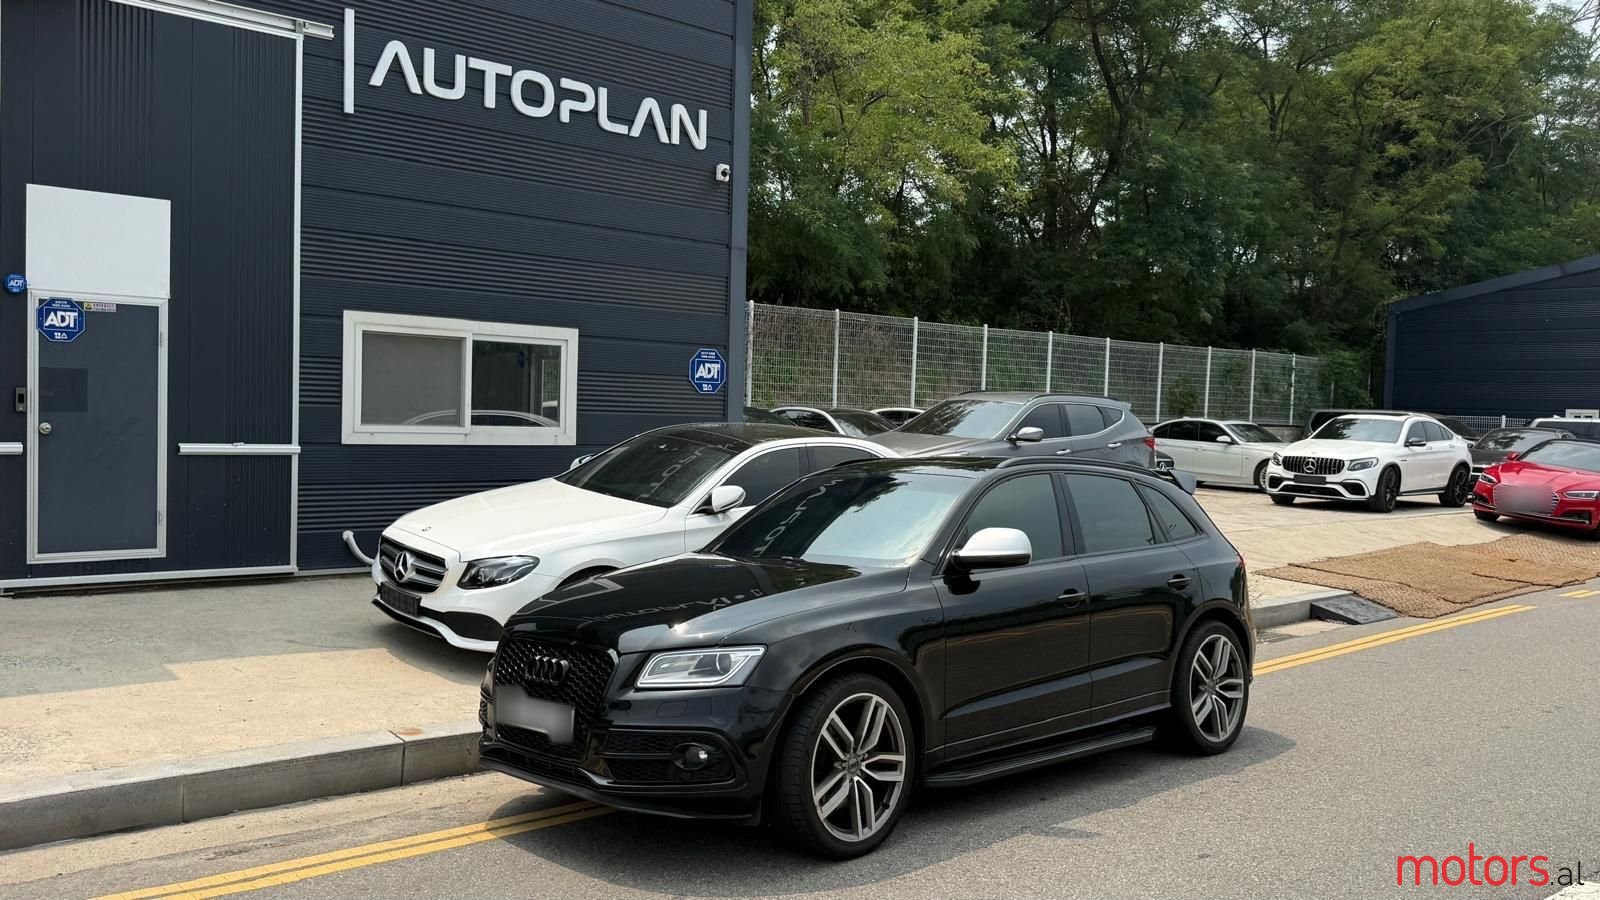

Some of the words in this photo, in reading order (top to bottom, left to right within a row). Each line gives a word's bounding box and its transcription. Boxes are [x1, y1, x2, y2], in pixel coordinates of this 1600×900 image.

[368, 40, 708, 151] AUTOPLAN
[8, 279, 24, 287] ADT
[45, 310, 78, 328] ADT
[695, 363, 720, 379] ADT
